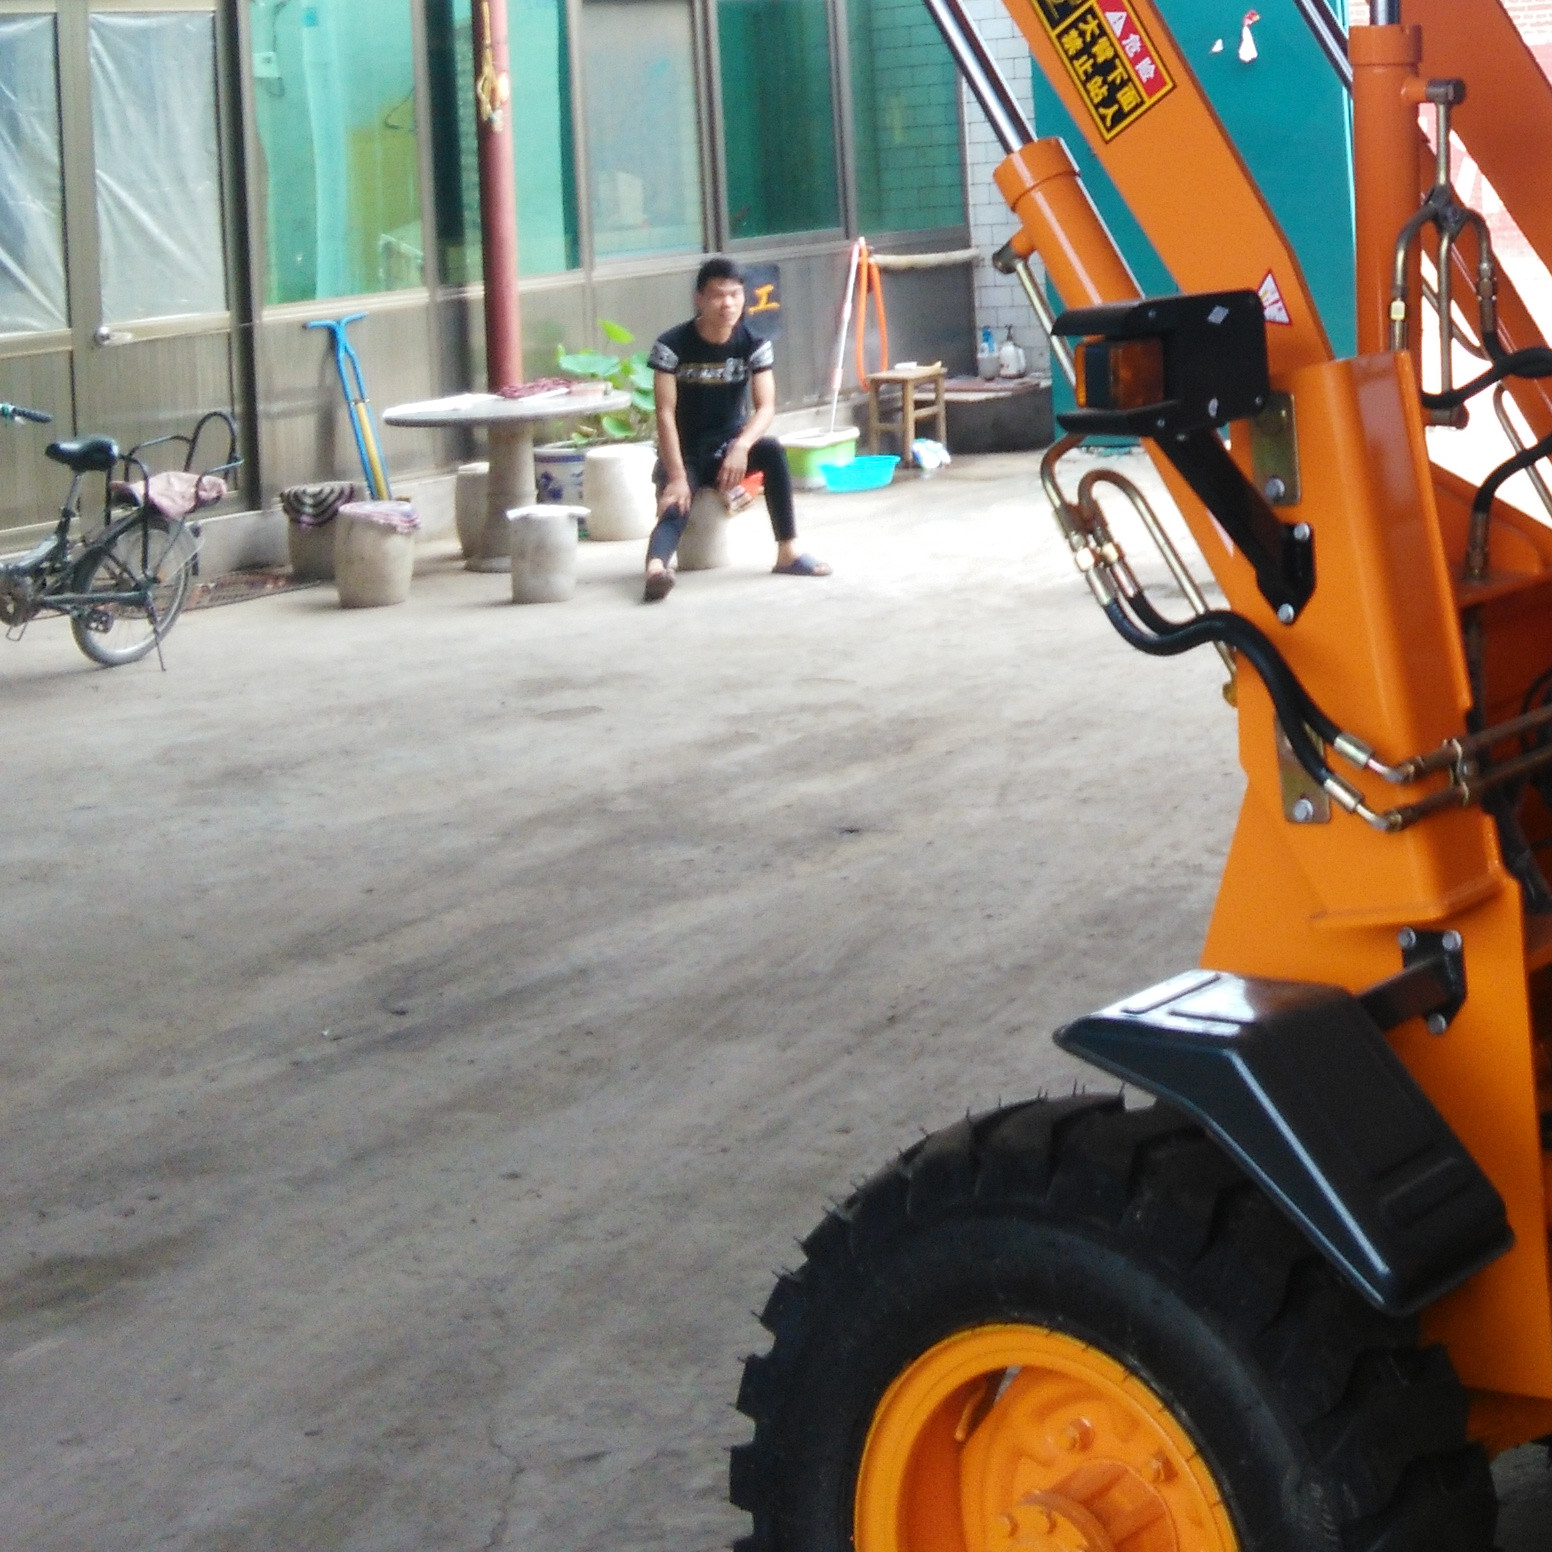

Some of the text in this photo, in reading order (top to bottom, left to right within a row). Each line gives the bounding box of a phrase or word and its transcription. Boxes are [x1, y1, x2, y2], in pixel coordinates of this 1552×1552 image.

[1061, 30, 1119, 127] 禁止站人
[1079, 14, 1141, 112] 大臂下面
[1122, 33, 1155, 83] 危险
